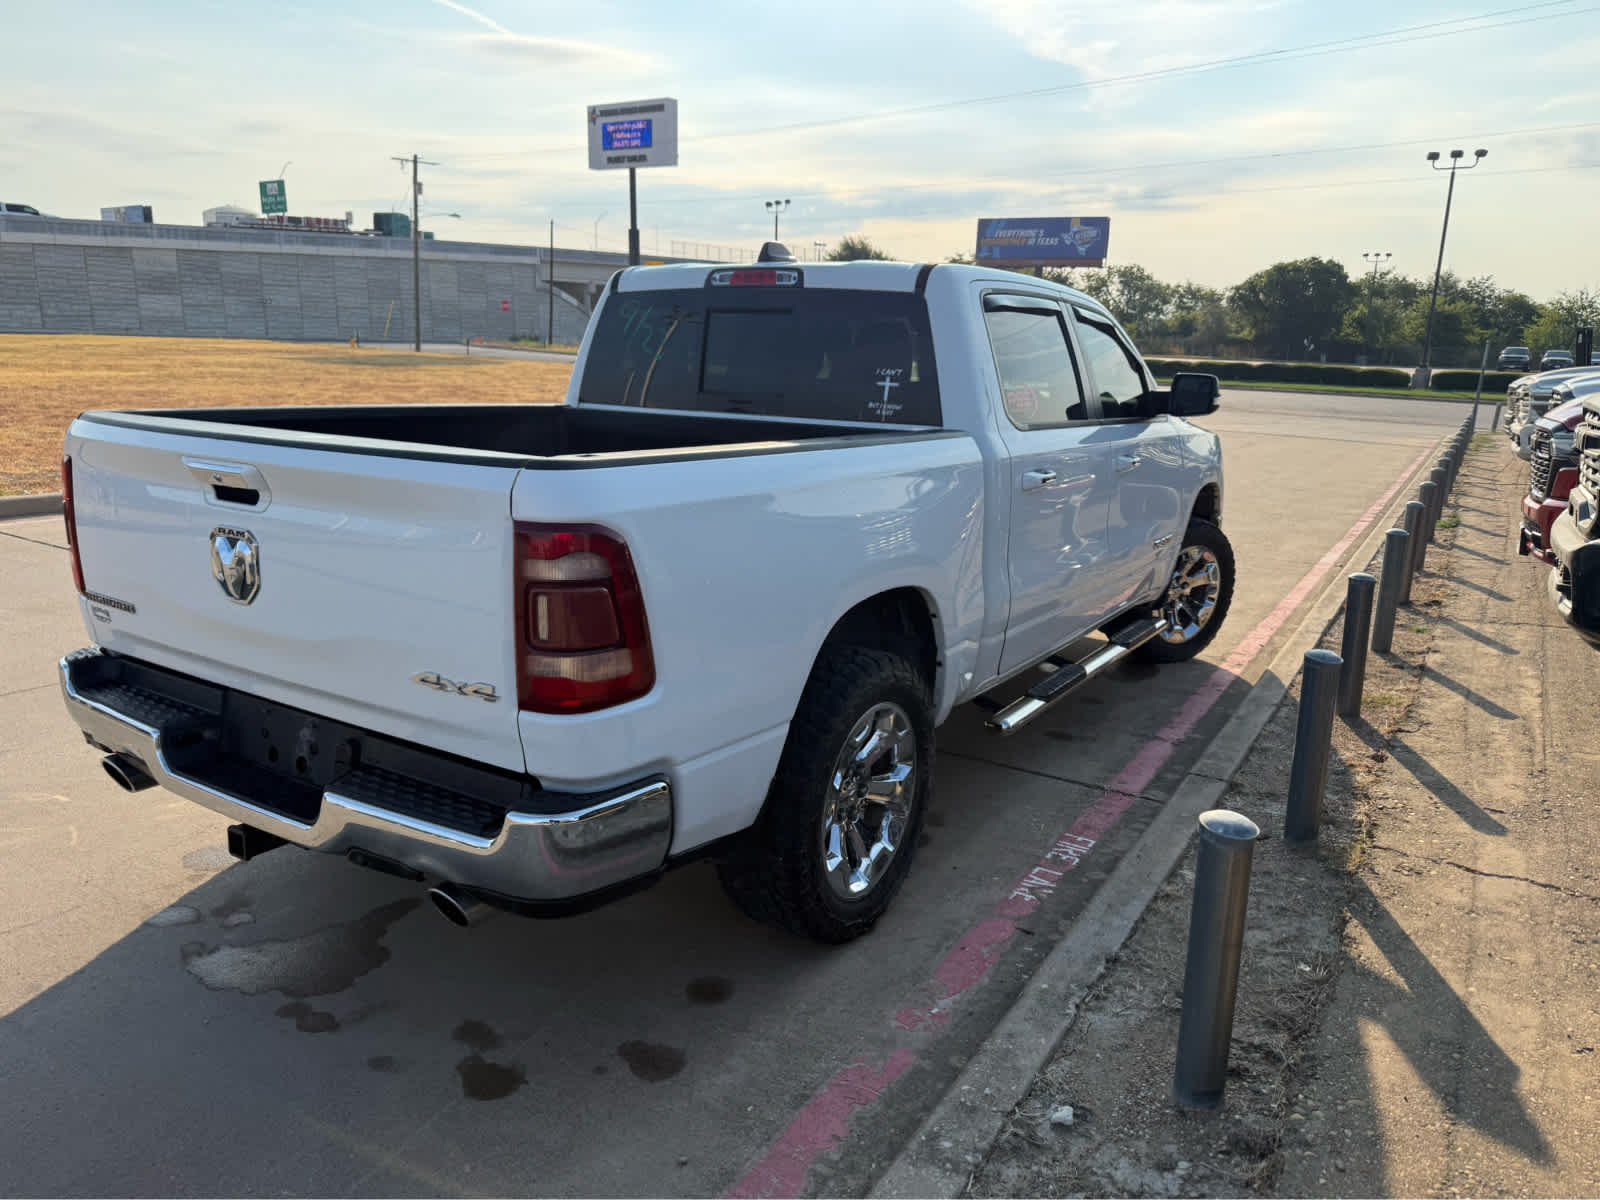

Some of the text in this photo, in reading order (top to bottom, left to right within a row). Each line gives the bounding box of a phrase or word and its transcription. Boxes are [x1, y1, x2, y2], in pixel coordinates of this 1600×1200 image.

[1036, 237, 1059, 246] TEXAS
[217, 527, 246, 538] RAM
[1009, 832, 1096, 901] FIRE LANE
